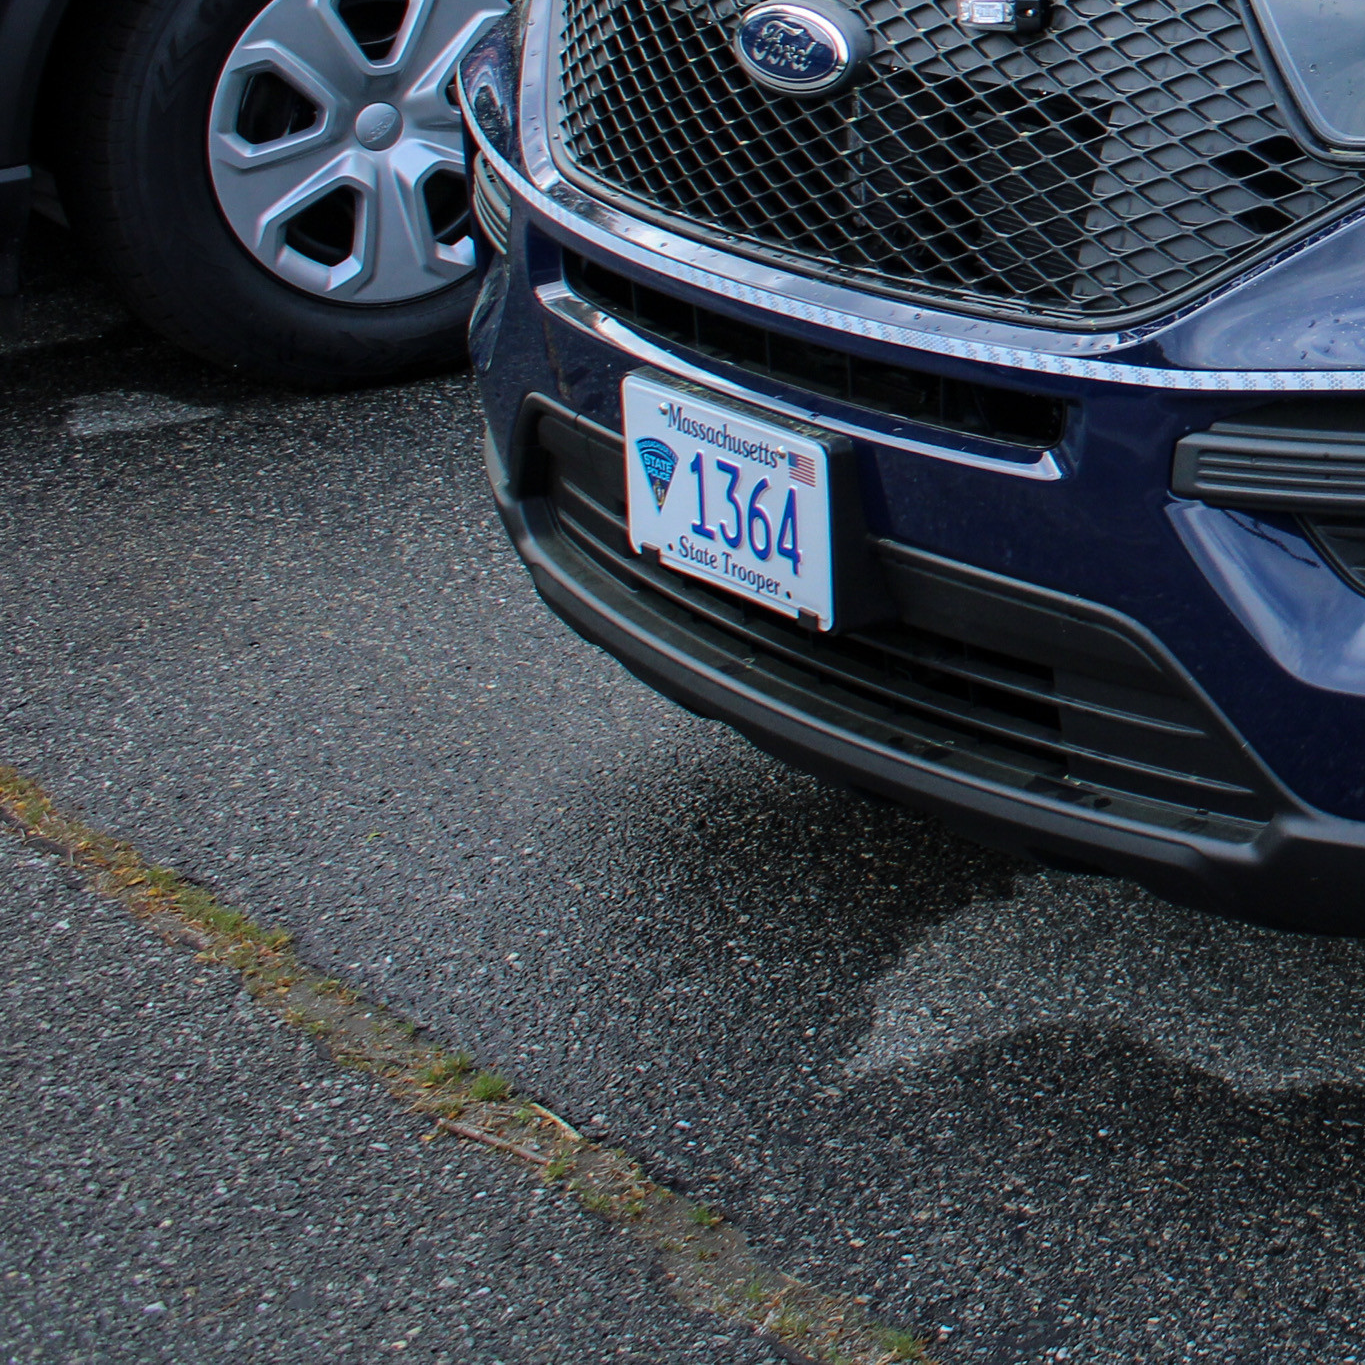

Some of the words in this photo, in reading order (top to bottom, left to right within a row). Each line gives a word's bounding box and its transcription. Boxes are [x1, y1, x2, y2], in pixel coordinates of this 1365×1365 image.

[752, 19, 817, 73] Ford
[643, 453, 674, 474] STATE
[667, 402, 780, 470] Massachusetts
[690, 449, 803, 576] 1364
[678, 534, 719, 570] State
[722, 551, 781, 596] Trooper
